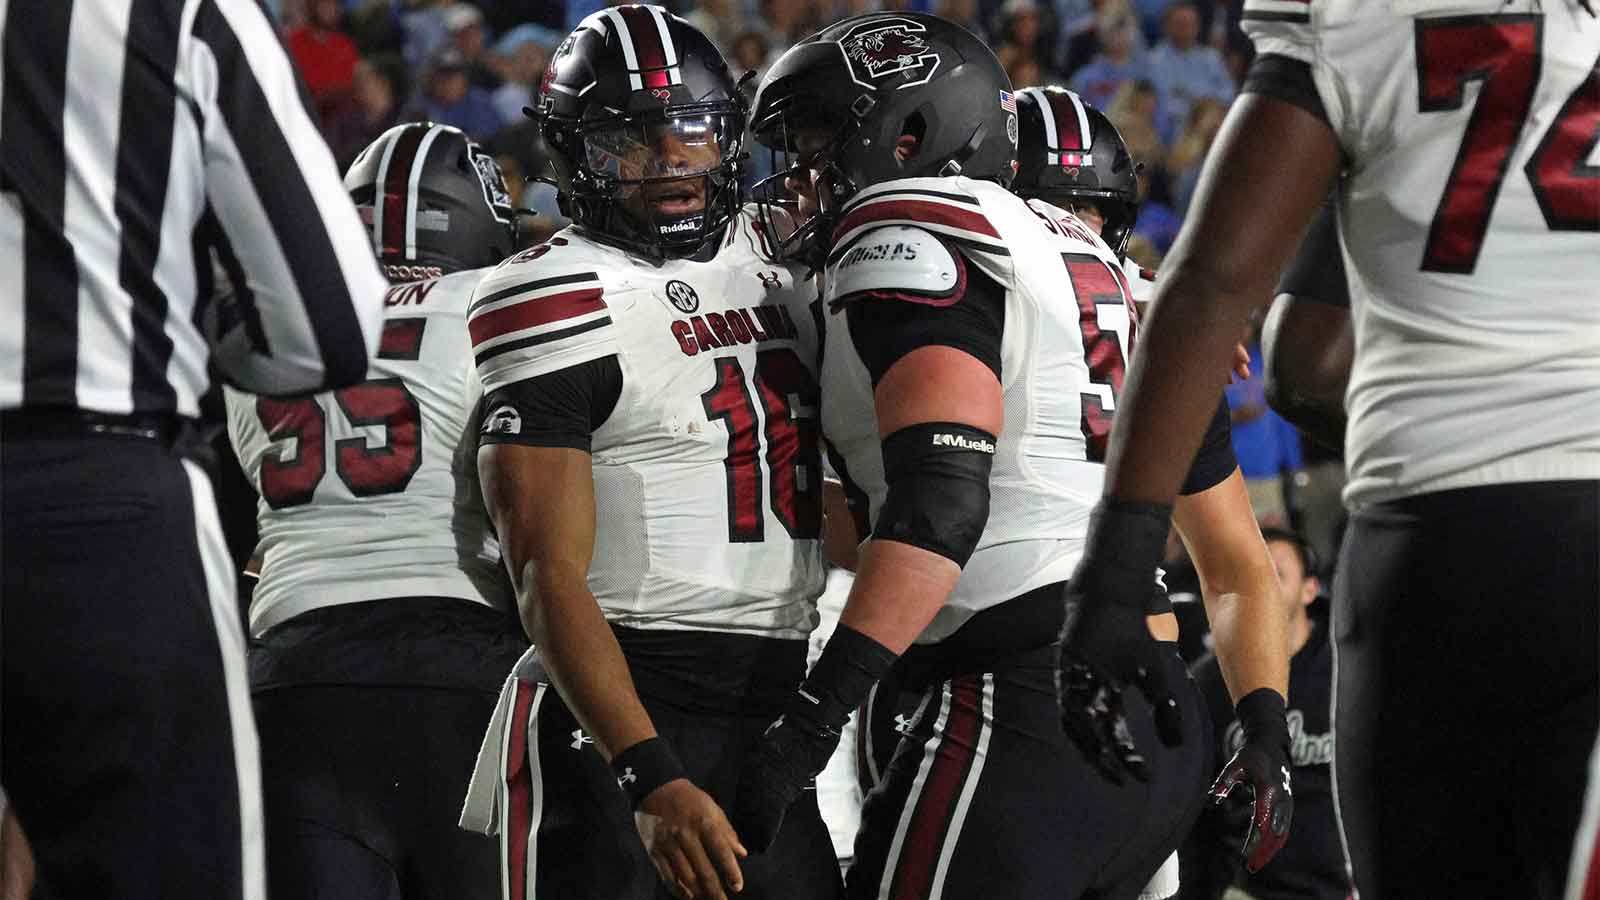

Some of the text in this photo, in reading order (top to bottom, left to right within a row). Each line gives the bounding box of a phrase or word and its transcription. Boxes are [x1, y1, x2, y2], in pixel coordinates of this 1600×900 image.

[660, 221, 695, 234] Riddell
[384, 265, 442, 281] COCKS
[667, 281, 698, 312] SEC
[671, 304, 799, 357] CAROLINA
[701, 349, 822, 543] 16
